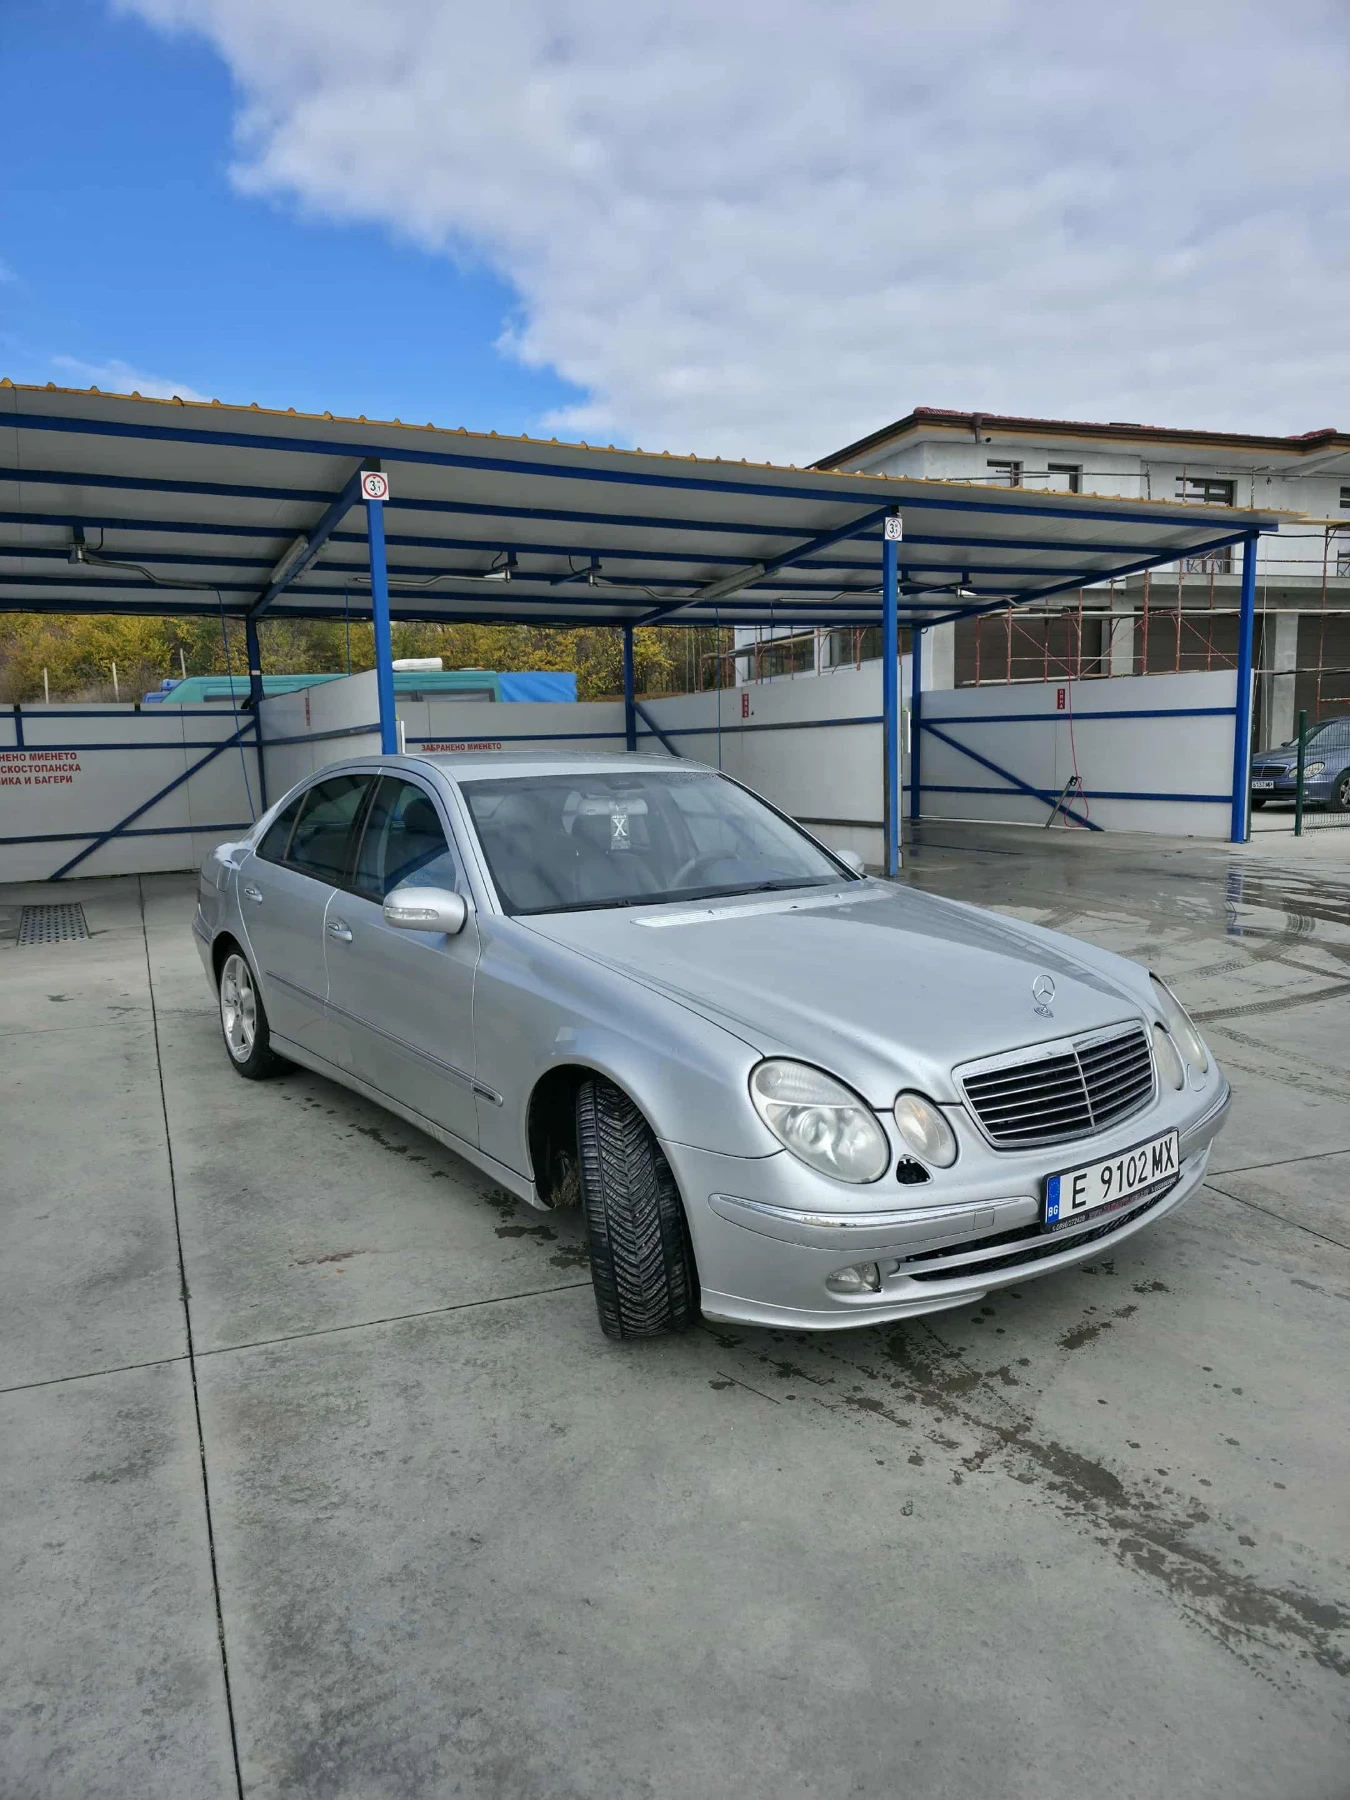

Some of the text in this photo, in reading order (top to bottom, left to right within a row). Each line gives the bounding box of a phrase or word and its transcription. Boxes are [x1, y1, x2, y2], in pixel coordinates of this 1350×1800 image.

[421, 742, 502, 752] ЗАБРАНЕНО МИЕНЕТО
[29, 752, 77, 761] МИЕНЕТО
[0, 764, 81, 774] СКОСТОПАНСКА
[0, 775, 73, 786] ИКА И БАГЕРИ
[1072, 1173, 1087, 1209] E
[1048, 1204, 1058, 1217] BG
